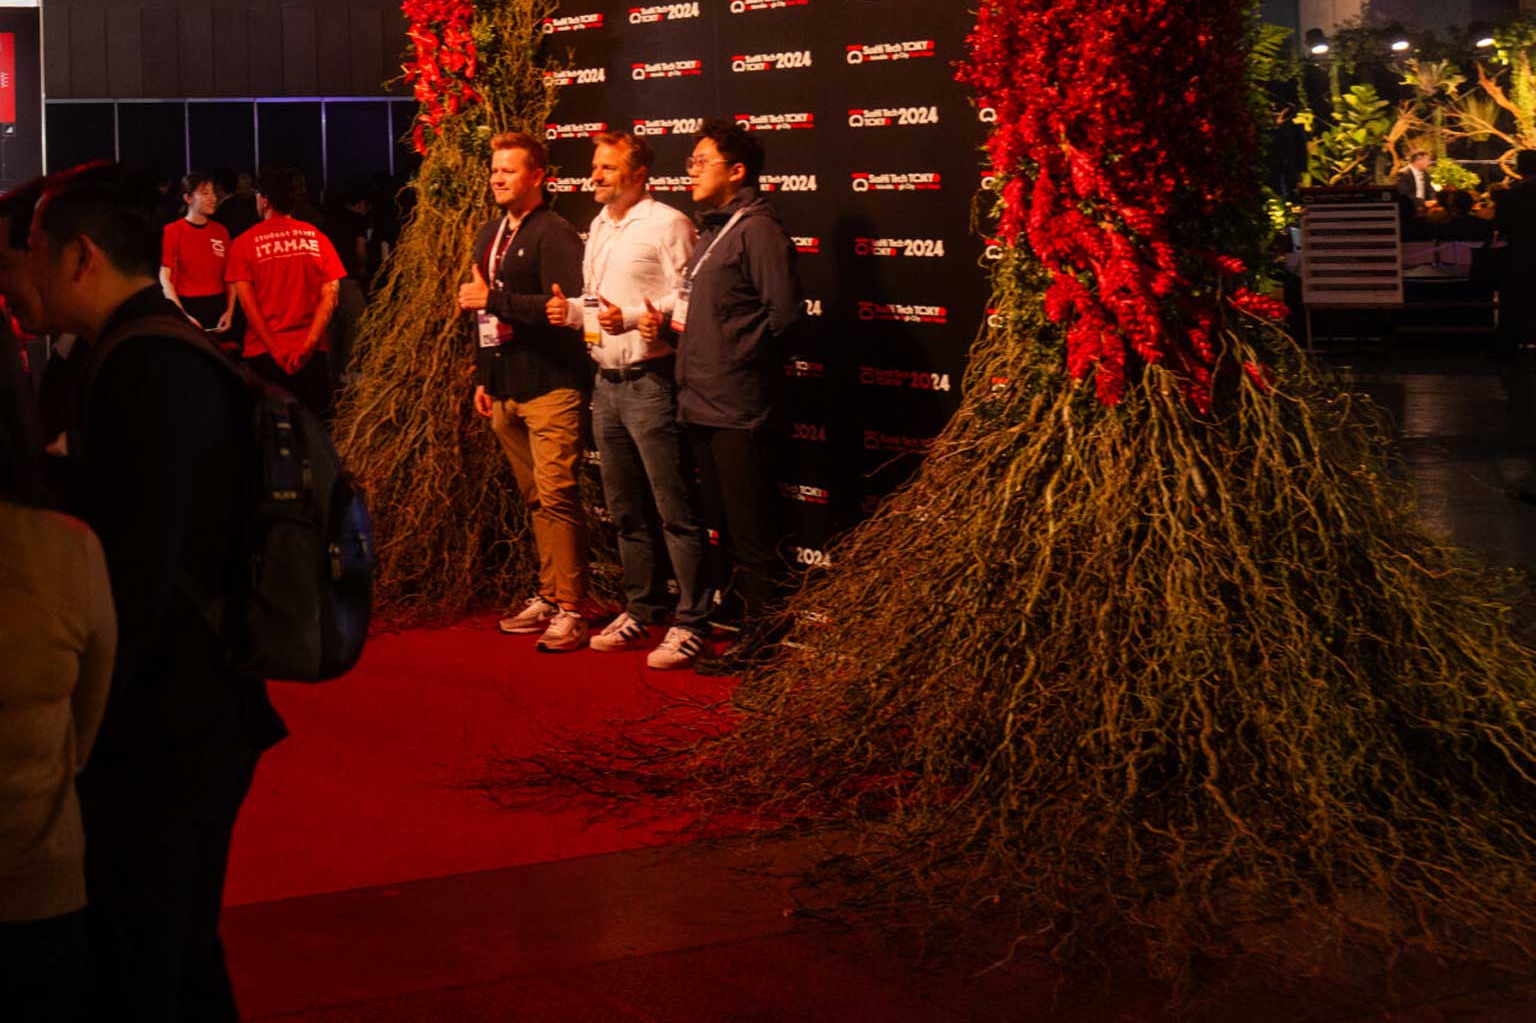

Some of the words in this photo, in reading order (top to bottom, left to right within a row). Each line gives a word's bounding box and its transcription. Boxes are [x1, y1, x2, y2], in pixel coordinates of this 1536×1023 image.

[667, 2, 699, 20] 2024
[776, 51, 812, 68] 2024
[577, 67, 606, 84] 2024
[898, 106, 939, 125] 2024
[581, 177, 595, 192] 20
[781, 175, 817, 191] 2024
[255, 238, 320, 258] ITAMAE
[904, 239, 944, 257] 2024
[804, 298, 823, 316] 24
